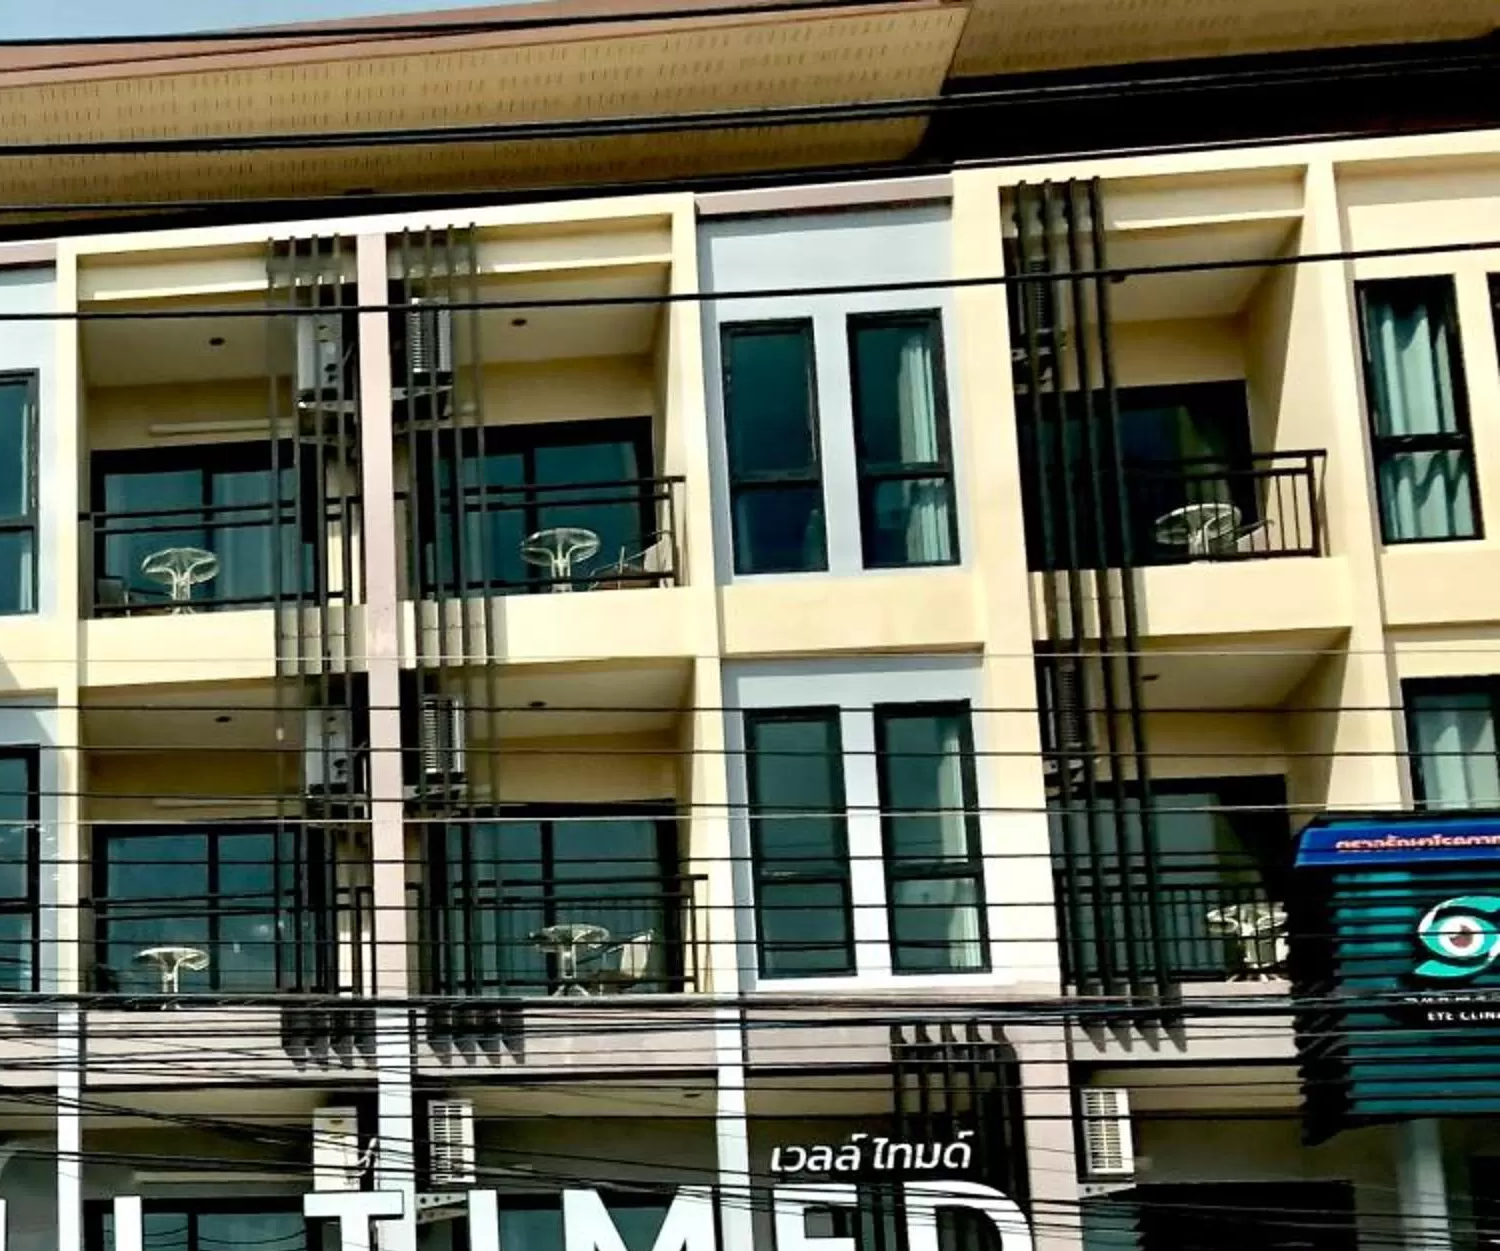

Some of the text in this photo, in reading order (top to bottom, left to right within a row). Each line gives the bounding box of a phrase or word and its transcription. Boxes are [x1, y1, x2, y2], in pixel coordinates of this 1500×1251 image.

[1427, 1011, 1454, 1021] EYE
[770, 1130, 975, 1172] เวลล์ ไทมด์
